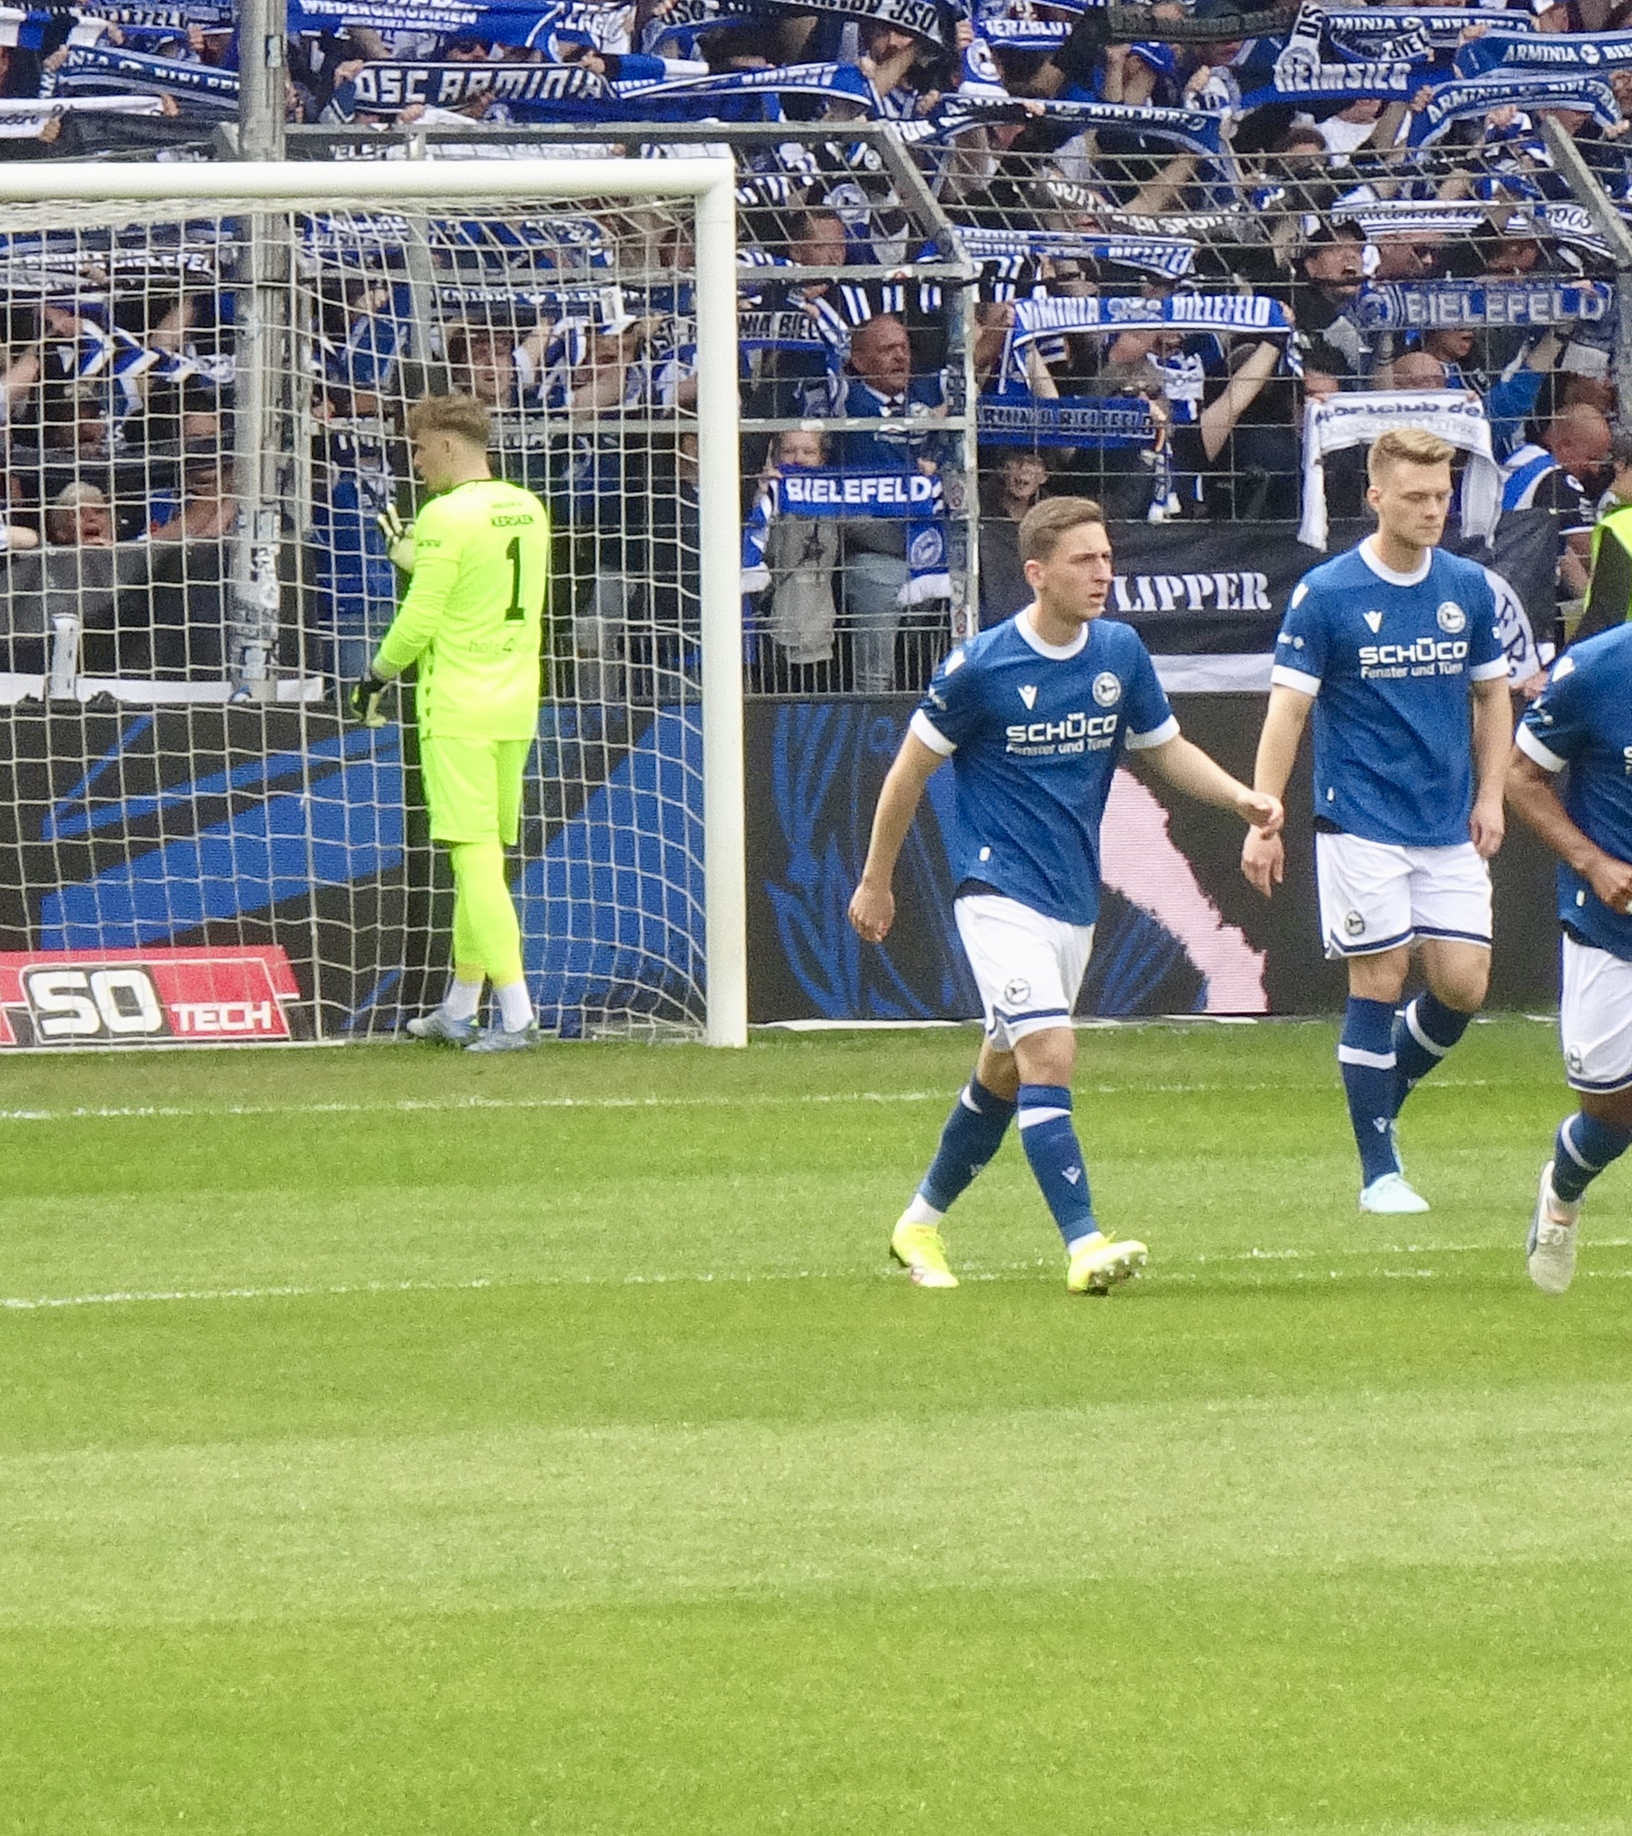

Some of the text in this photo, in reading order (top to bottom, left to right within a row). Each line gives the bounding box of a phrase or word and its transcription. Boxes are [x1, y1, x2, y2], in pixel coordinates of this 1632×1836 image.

[1506, 42, 1578, 63] ARMINIA
[1172, 297, 1269, 323] BIELEFELD
[1406, 289, 1607, 324] BIELEFELD
[787, 475, 928, 503] BIELEFELD
[504, 536, 526, 622] 1
[1113, 572, 1272, 611] LIPPER
[1359, 635, 1467, 666] SCHÜCO
[1361, 663, 1436, 680] Fenster und
[1005, 711, 1118, 744] SCHÜCO
[1059, 738, 1082, 754] und
[26, 967, 273, 1040] SO TECH
